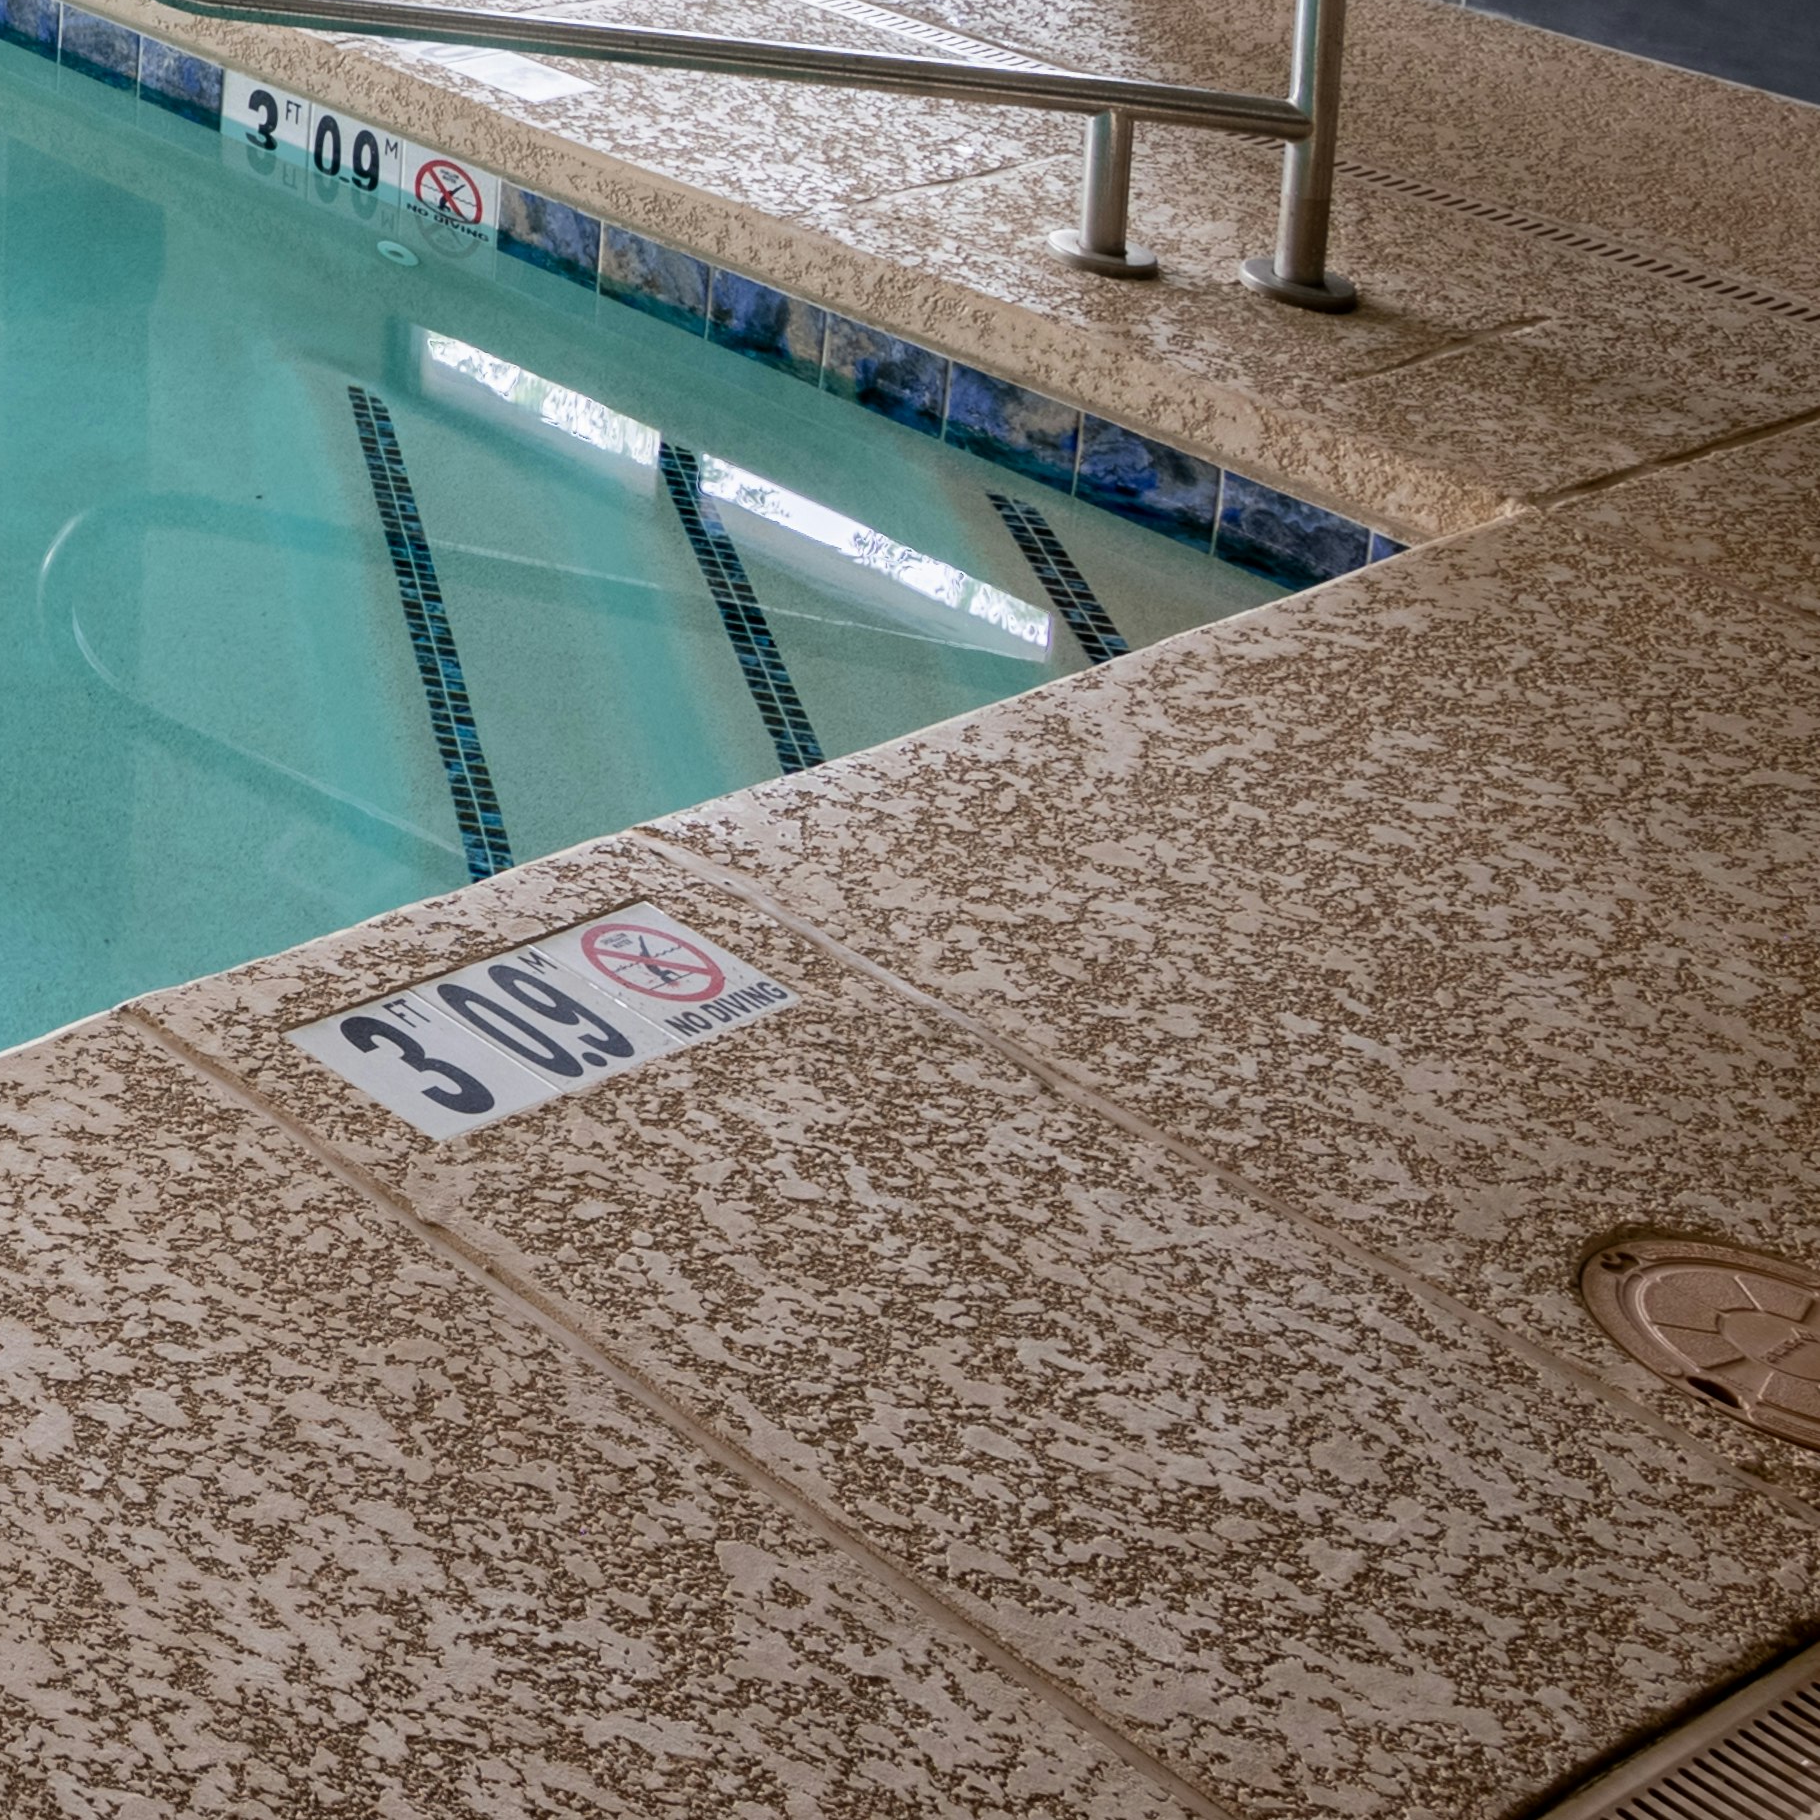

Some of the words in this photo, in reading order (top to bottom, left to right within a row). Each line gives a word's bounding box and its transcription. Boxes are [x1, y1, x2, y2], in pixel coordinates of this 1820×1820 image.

[244, 89, 279, 151] 3
[285, 100, 302, 125] FT
[384, 139, 399, 160] M
[406, 203, 429, 217] NO
[433, 216, 490, 242] DIVING
[515, 950, 559, 974] M
[381, 998, 433, 1030] FT
[436, 963, 636, 1078] 0.9
[663, 1010, 713, 1038] NO
[699, 980, 789, 1023] DIVING
[340, 1015, 495, 1114] 3
